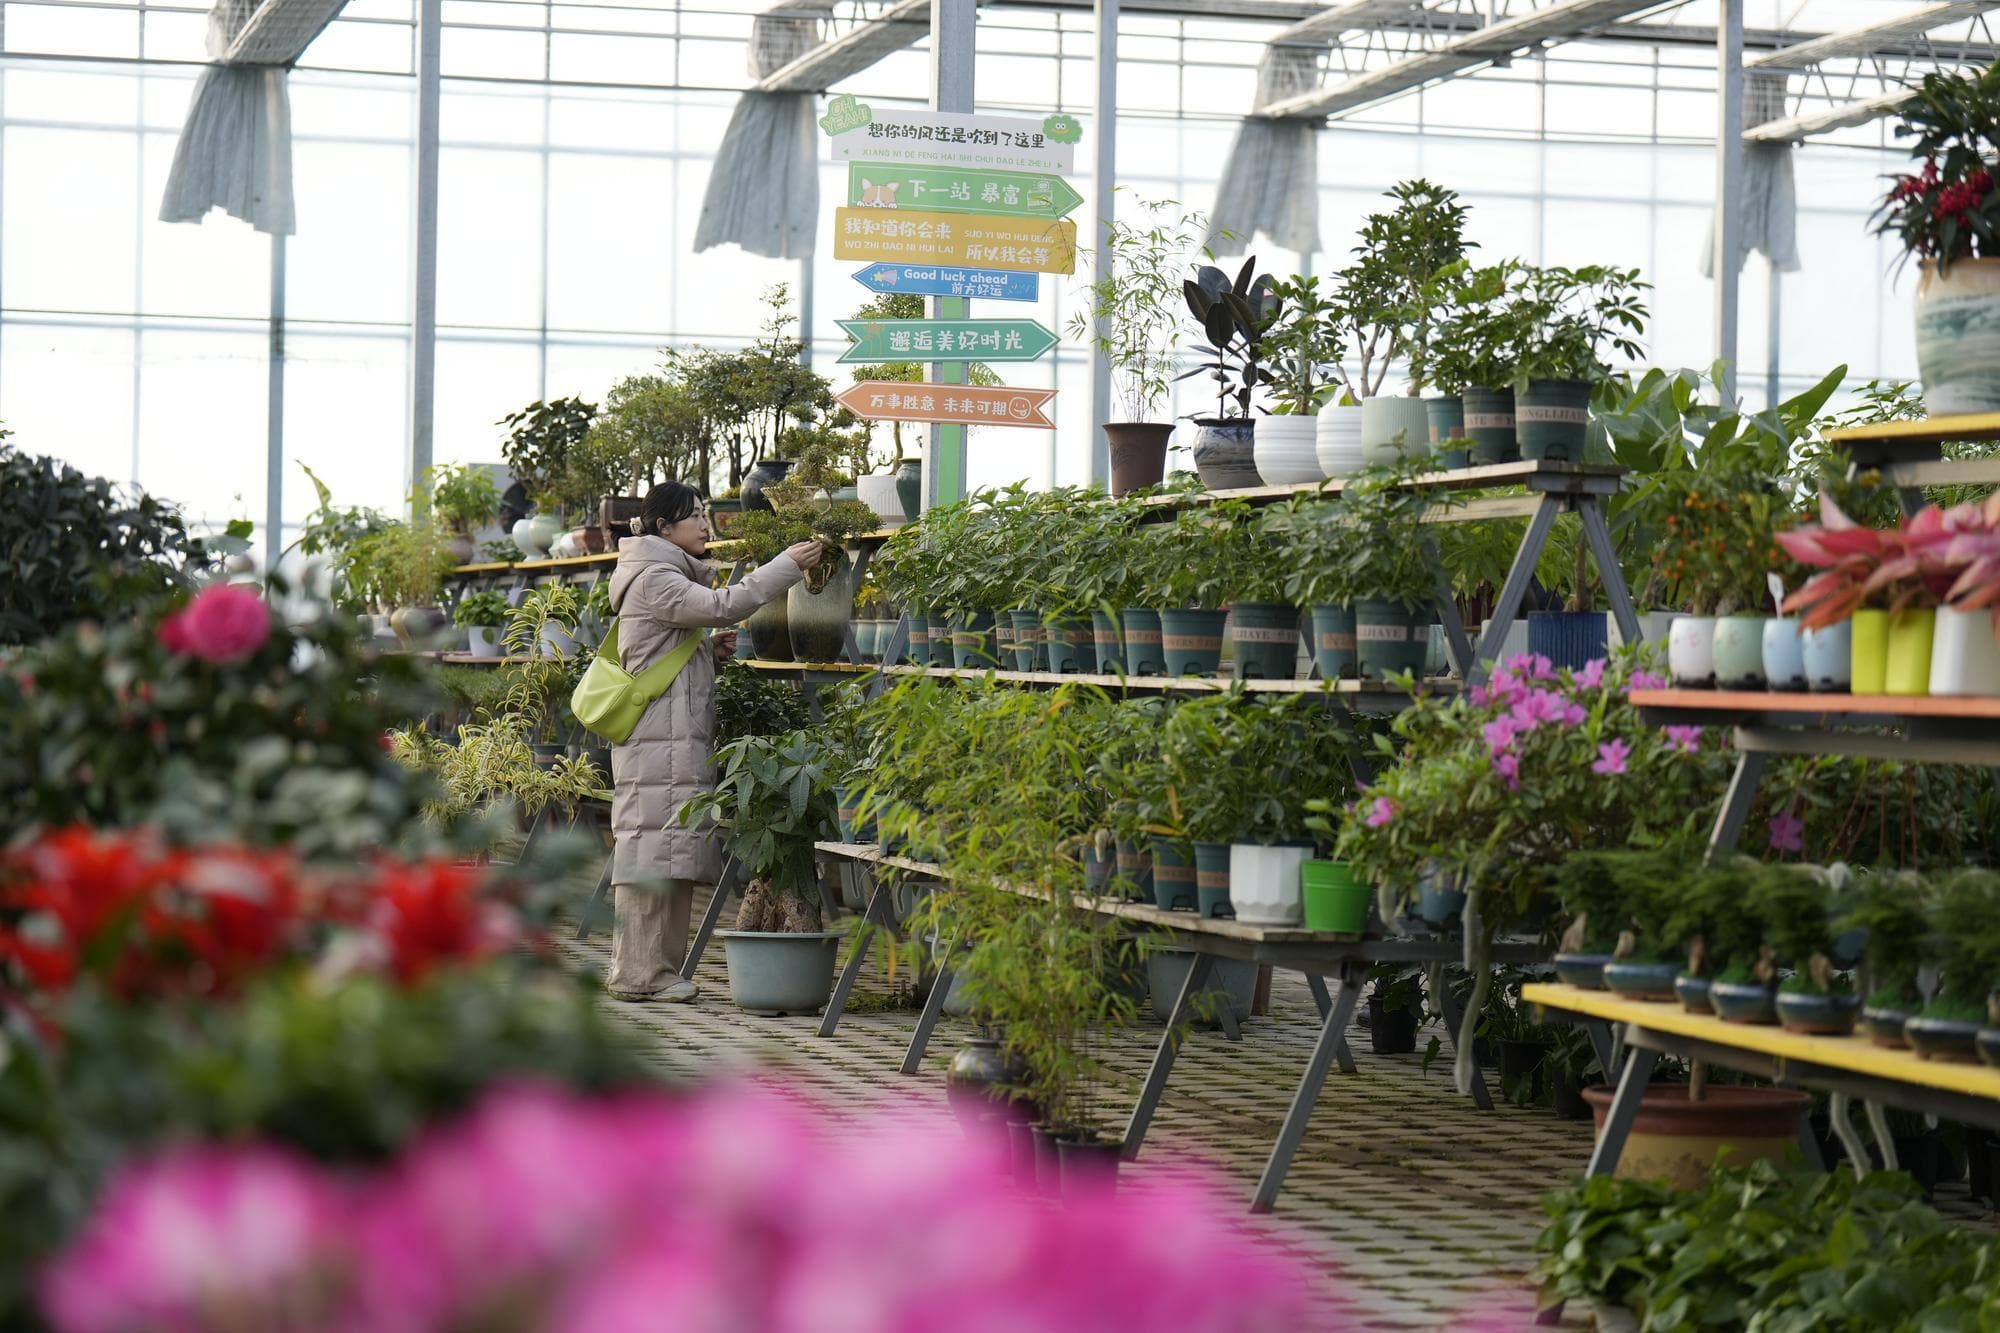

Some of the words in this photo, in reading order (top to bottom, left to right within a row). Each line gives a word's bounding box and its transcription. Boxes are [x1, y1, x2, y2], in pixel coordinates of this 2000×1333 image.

[868, 122, 1045, 148] 想你的风还是吹到了这里
[863, 148, 890, 157] XIANG
[918, 152, 938, 160] FENG
[976, 155, 993, 163] CHUI
[996, 157, 1014, 165] DAO
[908, 179, 970, 201] 下一站
[981, 182, 1020, 205] 暴富
[844, 217, 952, 239] 我知道你会来
[964, 229, 982, 238] SUO
[996, 231, 1011, 240] WO
[1014, 232, 1028, 241] HUI
[845, 240, 861, 249] WO
[864, 241, 879, 249] ZHI
[882, 241, 903, 251] DAO
[906, 243, 916, 251] NI
[919, 243, 934, 252] HUI
[938, 245, 954, 254] LAI
[966, 244, 1049, 266] 所以我会等
[904, 268, 936, 280] Good
[941, 270, 966, 282] luck
[970, 272, 1008, 284] ahead
[951, 282, 1002, 297] 前方好运
[889, 330, 1023, 352] 邂逅美好时光
[870, 393, 935, 411] 万事胜意
[943, 398, 1007, 416] 未来可期
